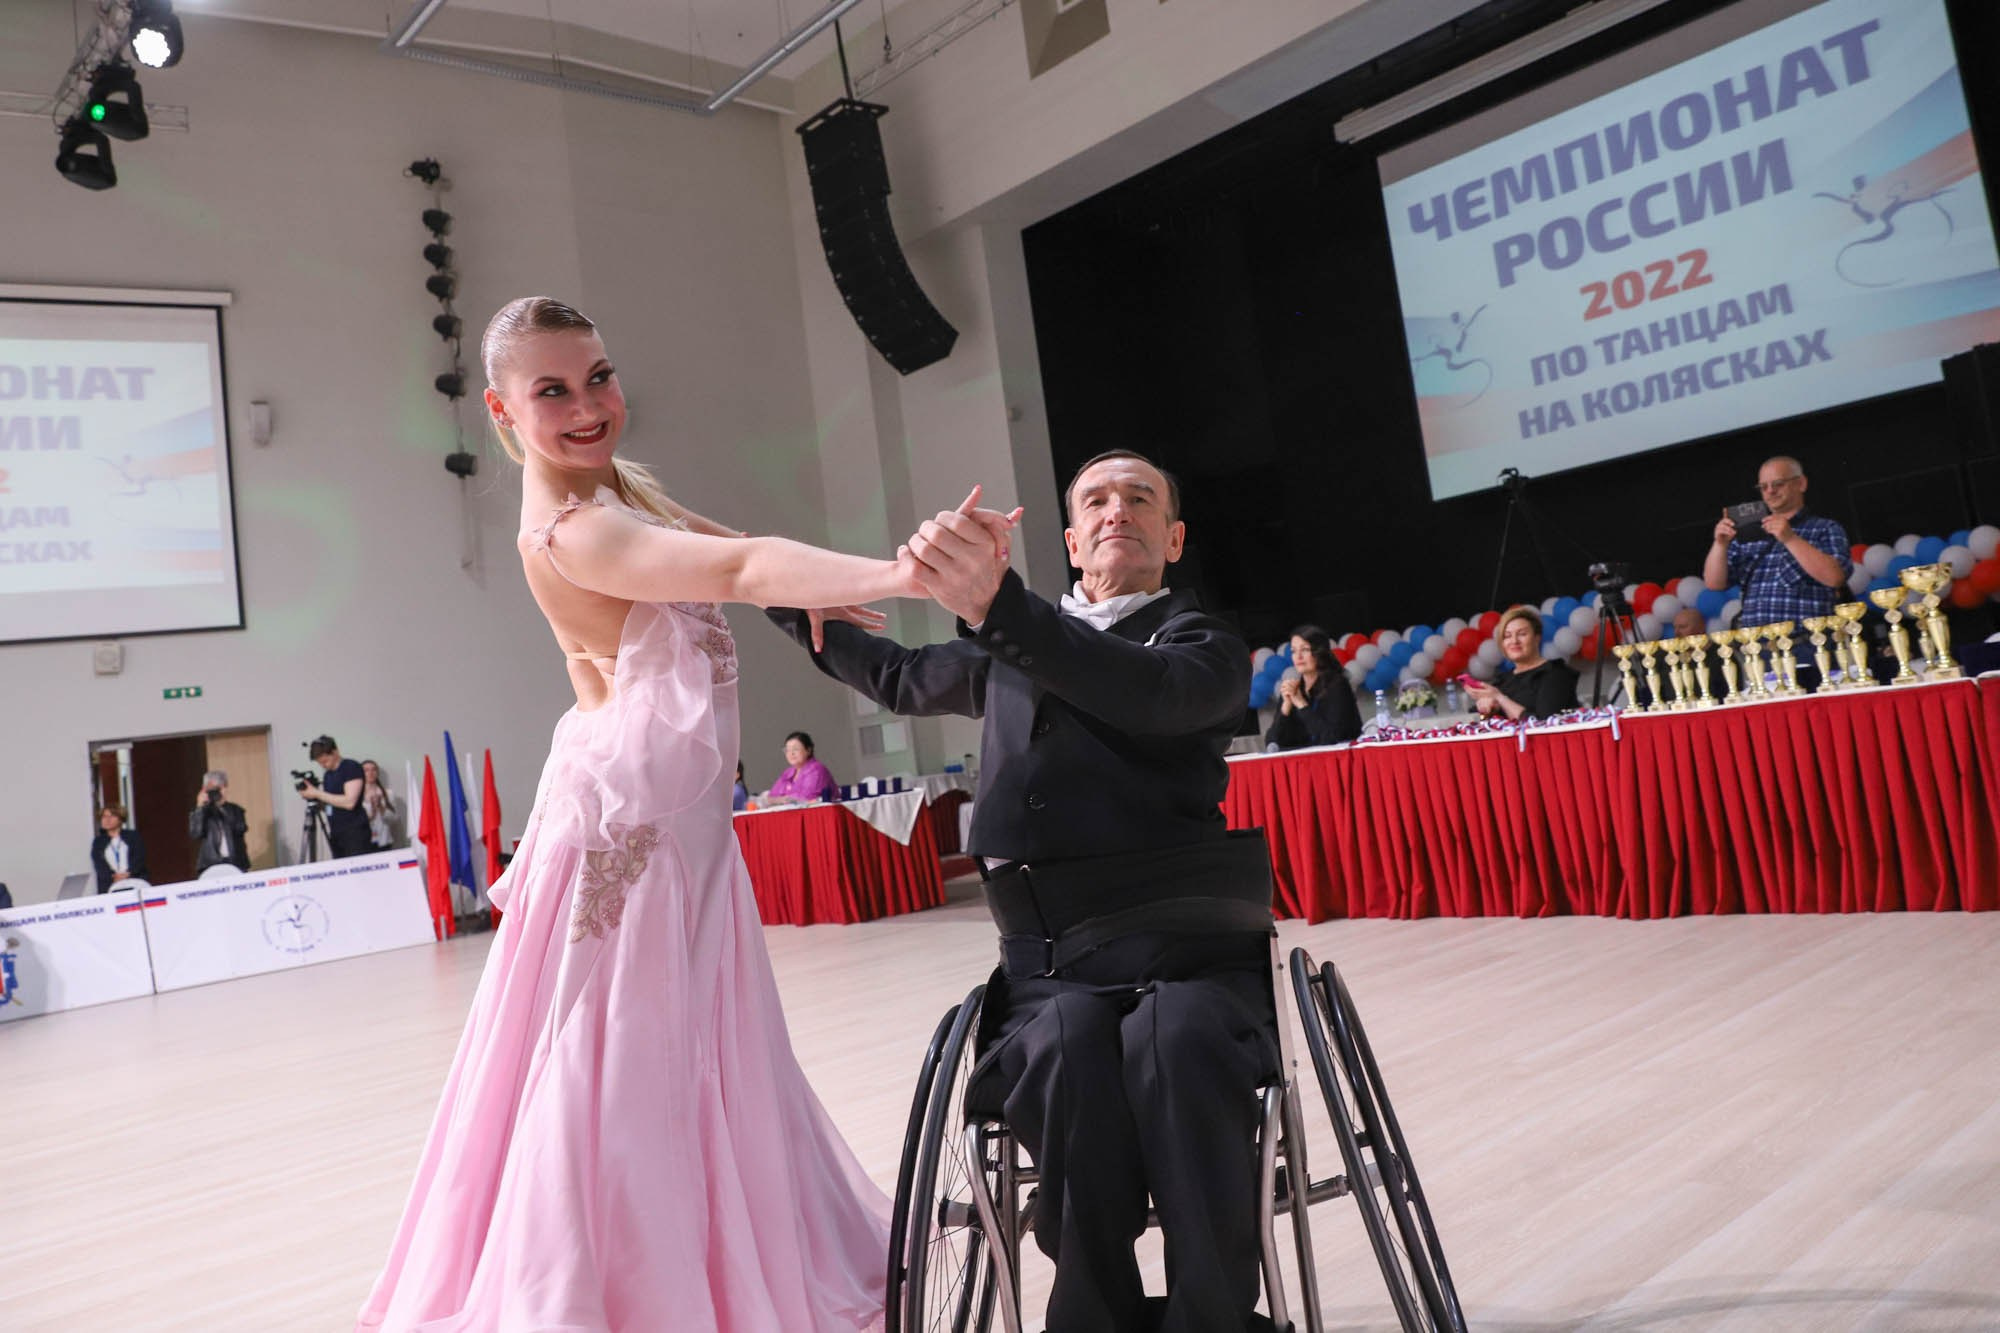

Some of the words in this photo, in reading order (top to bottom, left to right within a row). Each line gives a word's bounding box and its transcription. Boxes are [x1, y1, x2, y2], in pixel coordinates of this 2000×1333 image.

[1406, 18, 1881, 242] ЧЕМПИОНАТ
[1492, 137, 1794, 289] РОССИИ
[1530, 345, 1588, 386] ПО
[1593, 283, 1794, 367] ТАНЦАМ
[1579, 247, 1714, 322] 2022
[1517, 401, 1576, 439] НА
[1583, 328, 1833, 423] КОЛЯСКАХ
